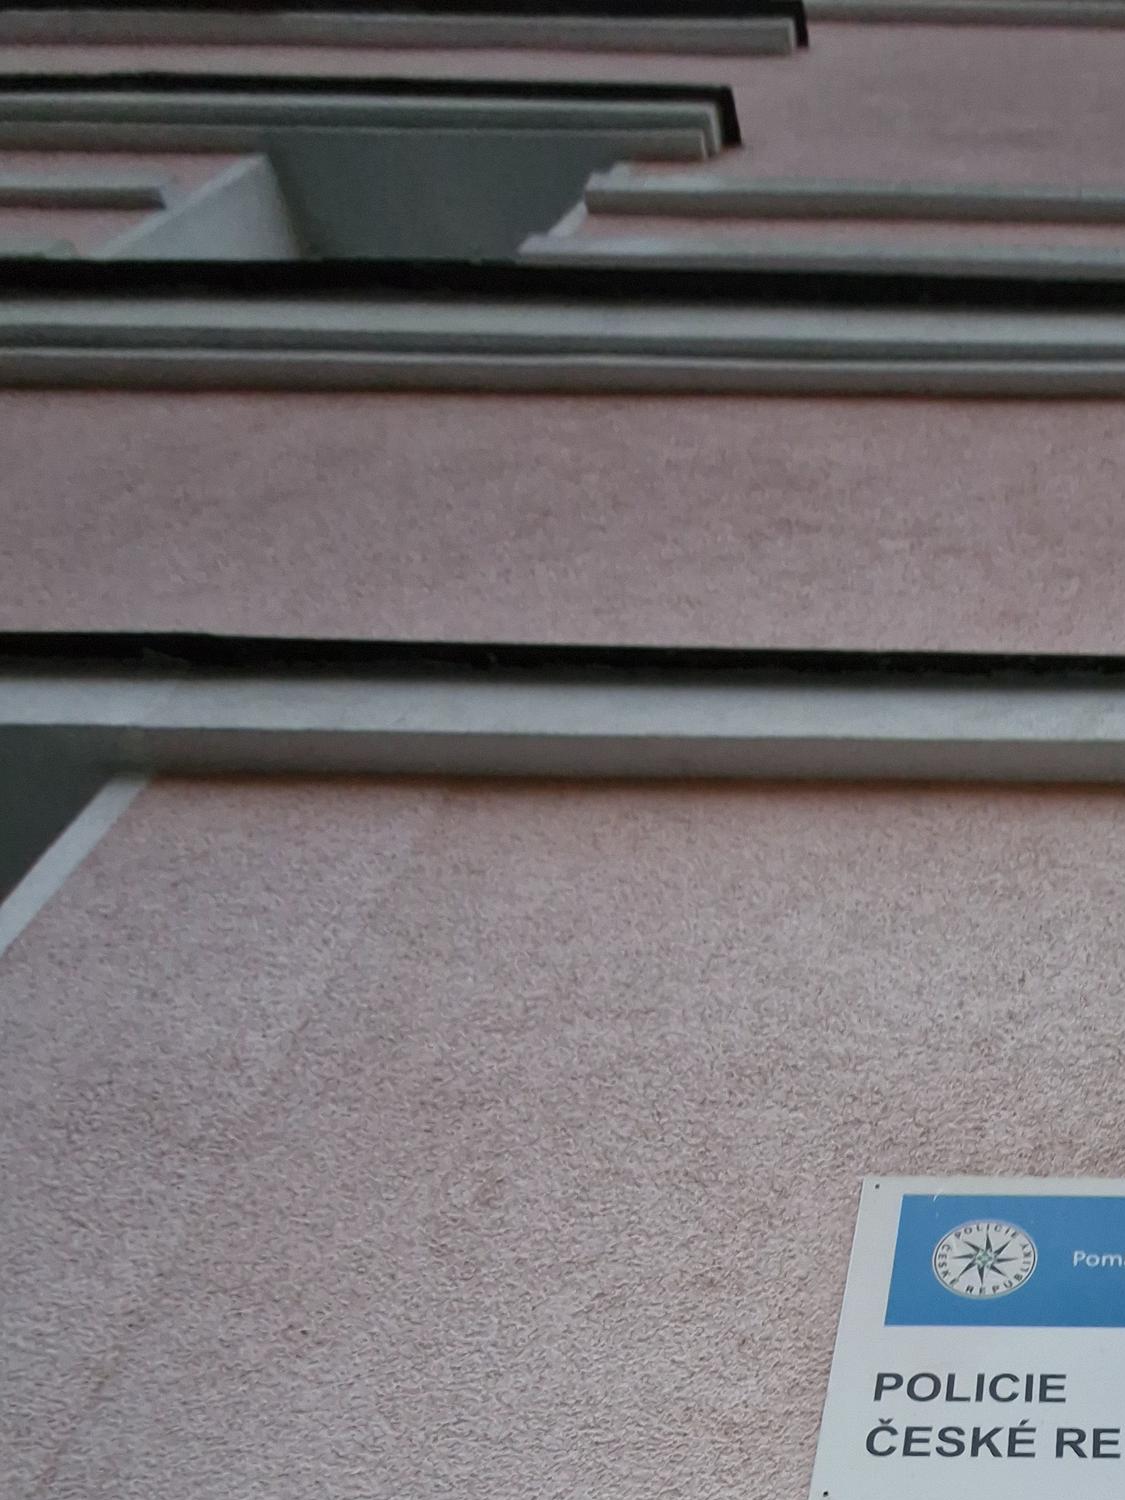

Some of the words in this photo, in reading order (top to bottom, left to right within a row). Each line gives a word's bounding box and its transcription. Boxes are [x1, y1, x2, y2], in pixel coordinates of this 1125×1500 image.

[954, 1223, 1018, 1240] POLICIE
[873, 1372, 1067, 1403] POLICIE
[865, 1418, 1037, 1458] ČESKÉ
